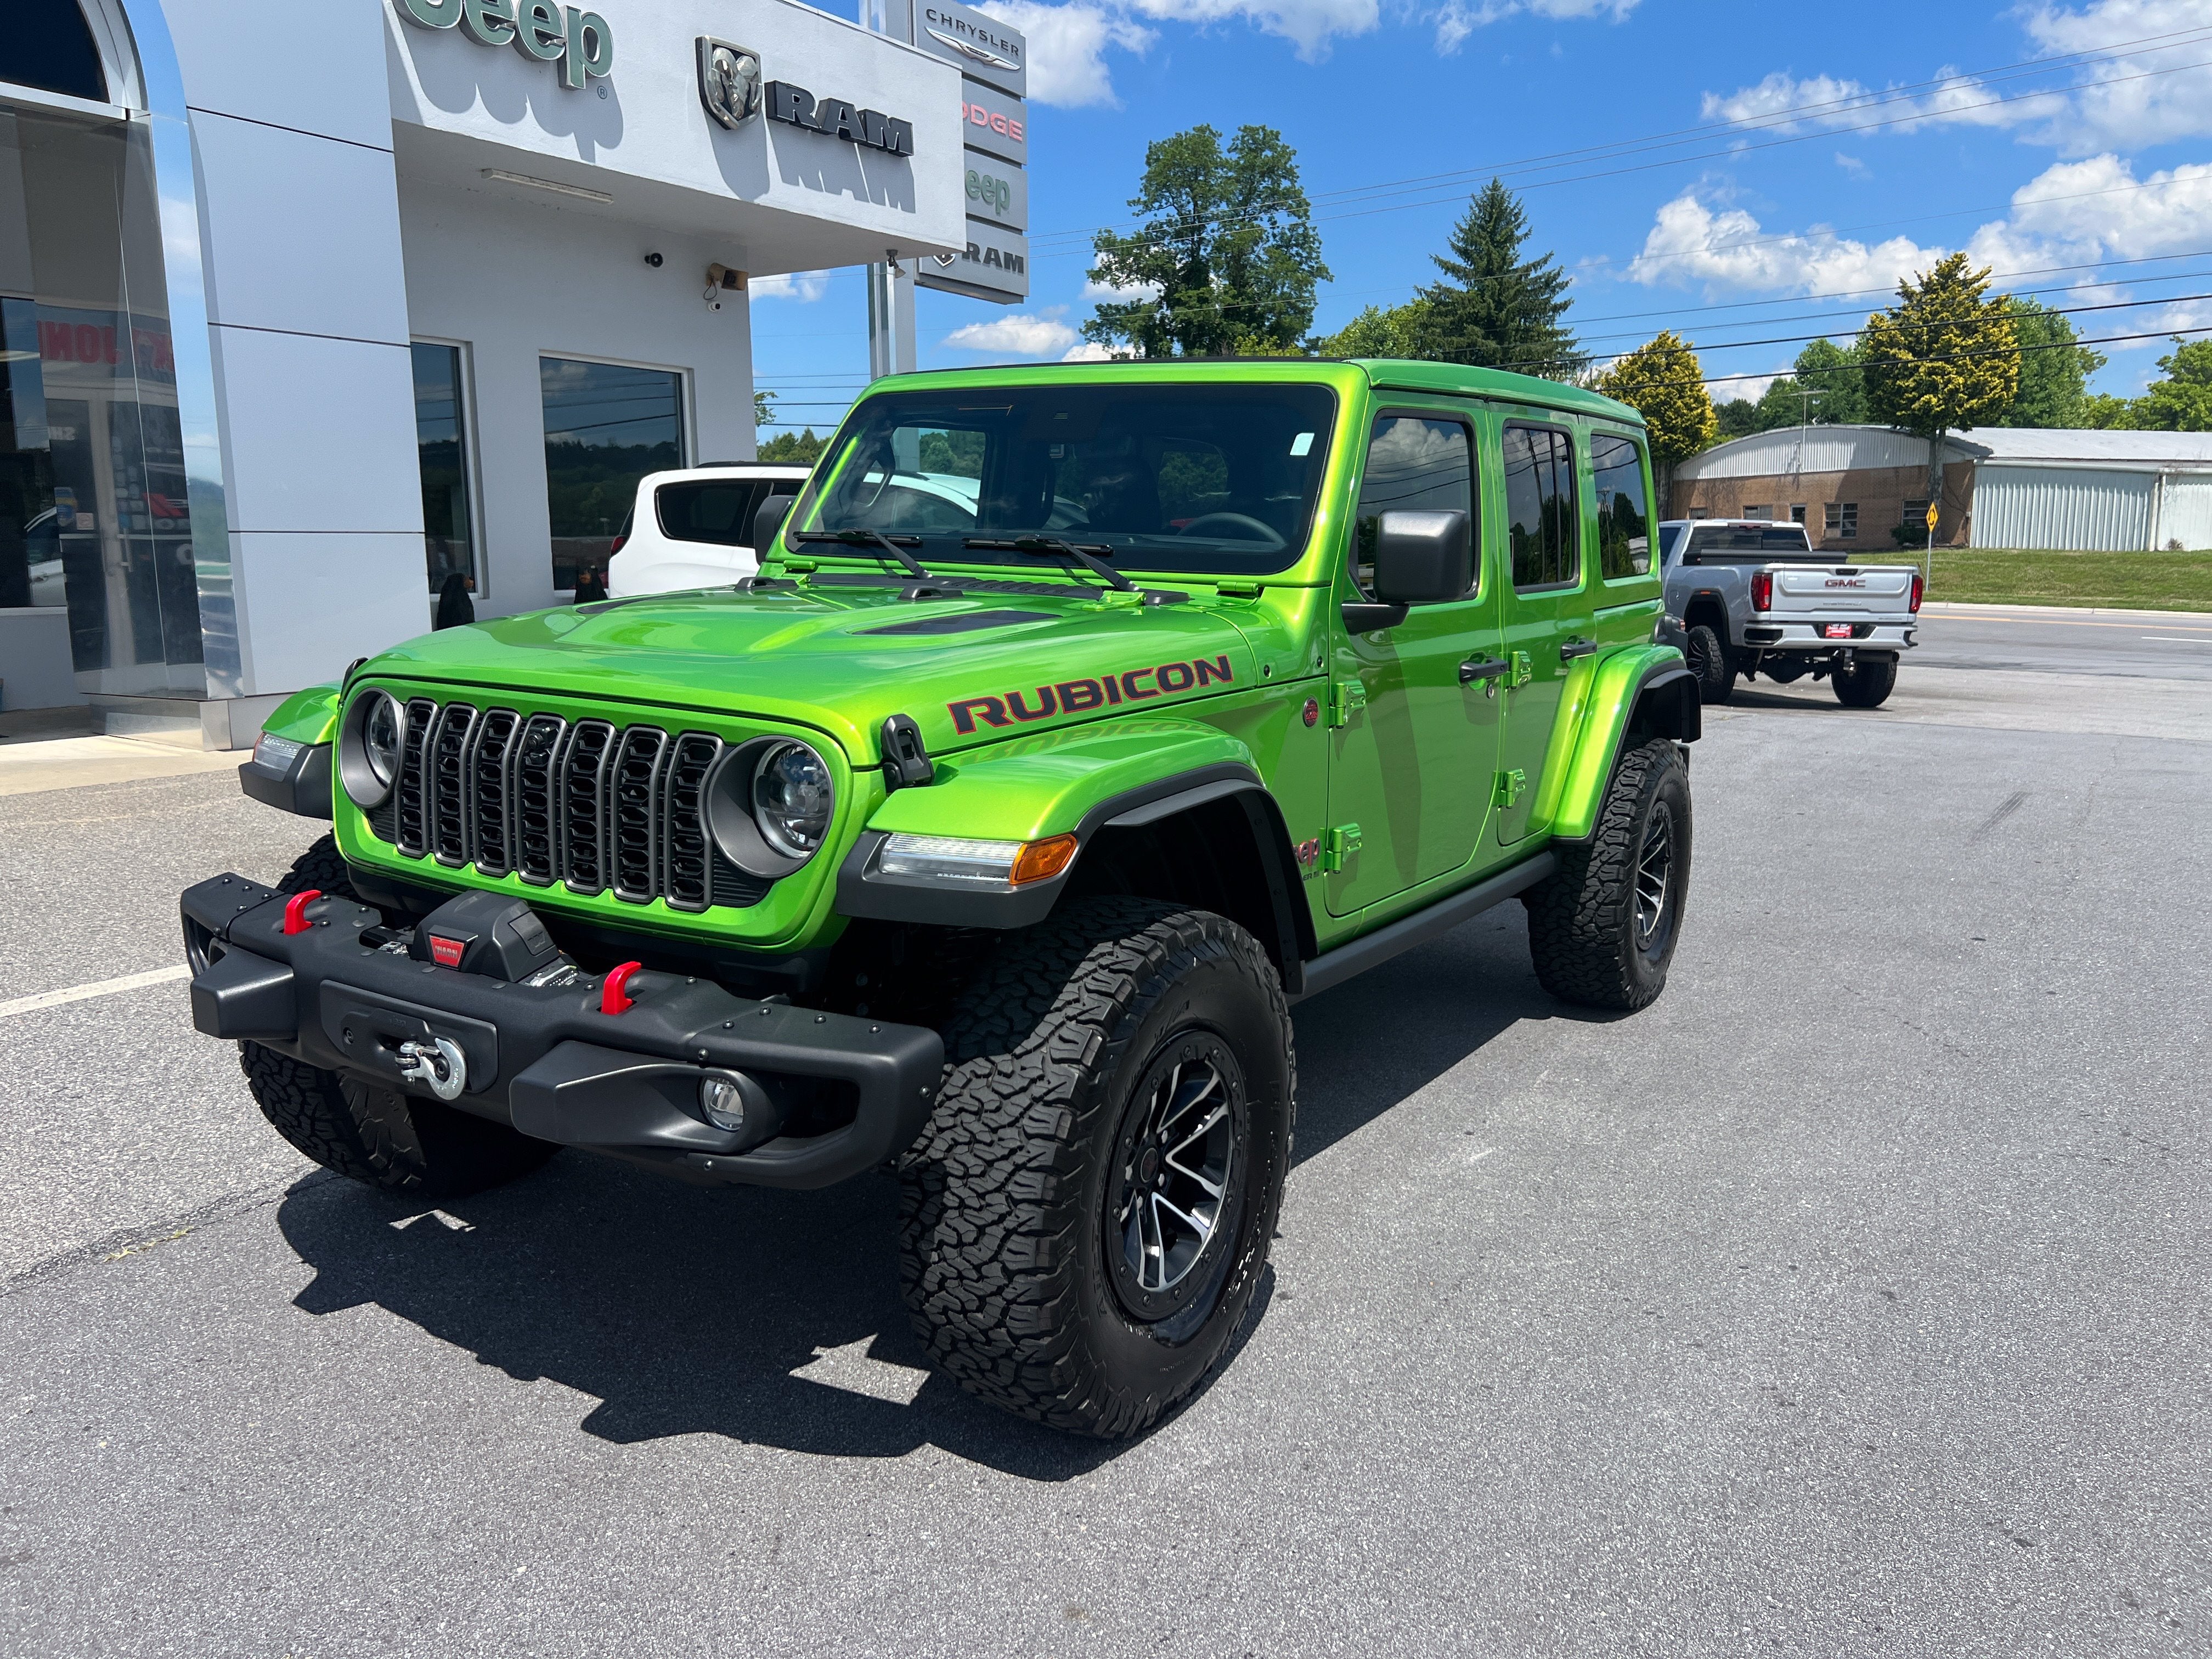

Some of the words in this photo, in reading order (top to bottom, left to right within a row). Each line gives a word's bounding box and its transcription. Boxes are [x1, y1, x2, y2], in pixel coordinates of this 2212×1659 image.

[926, 8, 1019, 57] CHRYSLER
[765, 80, 914, 157] RAM
[965, 170, 1011, 217] eep
[961, 241, 1024, 275] RAM
[1825, 579, 1866, 588] GMC
[946, 654, 1234, 735] RUBICON
[435, 945, 458, 958] WARN
